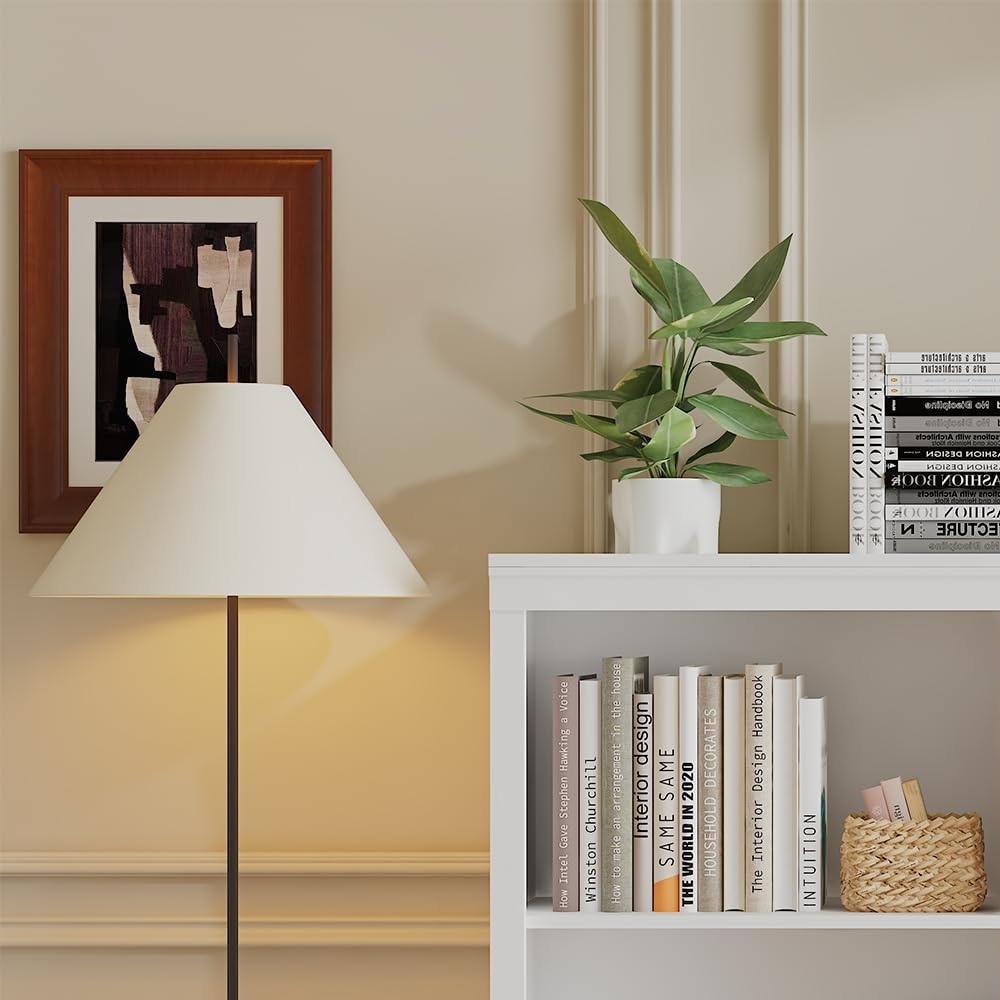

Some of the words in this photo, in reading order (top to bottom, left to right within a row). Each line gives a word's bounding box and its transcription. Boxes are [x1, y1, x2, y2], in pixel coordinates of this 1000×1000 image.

[558, 680, 569, 713] Voice
[611, 663, 621, 694] house
[611, 701, 621, 718] the
[751, 675, 764, 737] Handbook
[558, 728, 571, 773] Hawking
[611, 725, 621, 736] in
[634, 702, 652, 766] design
[704, 708, 717, 787] DECORATES
[612, 744, 623, 811] arrangement
[659, 749, 674, 800] SAME
[682, 762, 694, 800] 2020
[751, 745, 767, 792] Design
[558, 778, 571, 820] Stephen
[584, 756, 597, 834] Churchill
[634, 771, 649, 839] Interior
[682, 805, 694, 819] IN
[557, 823, 569, 849] Gave
[613, 817, 621, 829] an
[659, 815, 674, 866] SAME
[704, 797, 717, 877] HOUSEHOLD
[751, 800, 764, 862] Interior
[611, 835, 621, 860] make
[682, 824, 694, 876] WORLD
[803, 815, 816, 906] INTUITION
[557, 854, 569, 884] Intel
[584, 842, 597, 903] Winston
[612, 866, 621, 878] to
[751, 870, 764, 894] The
[558, 892, 569, 909] How
[611, 885, 621, 903] How
[682, 881, 694, 906] THE
